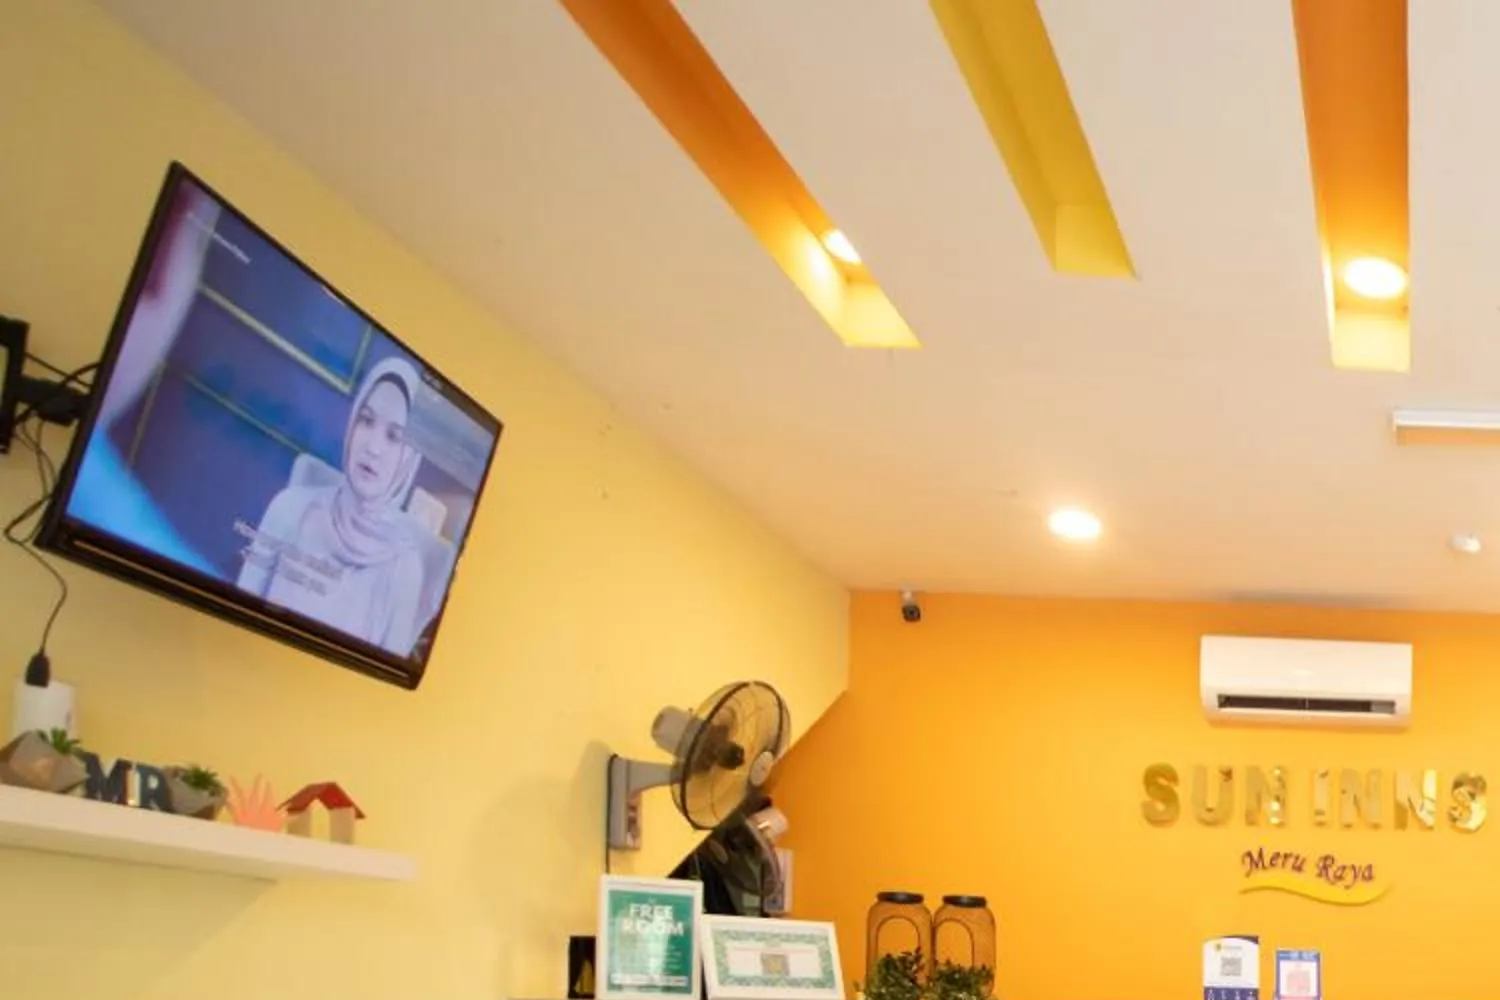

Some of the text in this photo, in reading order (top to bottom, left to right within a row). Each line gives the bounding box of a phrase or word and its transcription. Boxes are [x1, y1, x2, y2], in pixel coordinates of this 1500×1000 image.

[84, 751, 173, 813] MR
[1142, 762, 1488, 834] SUN INNS
[1241, 847, 1375, 890] Meru Raya
[622, 919, 684, 936] ROOM
[629, 903, 673, 921] FREE
